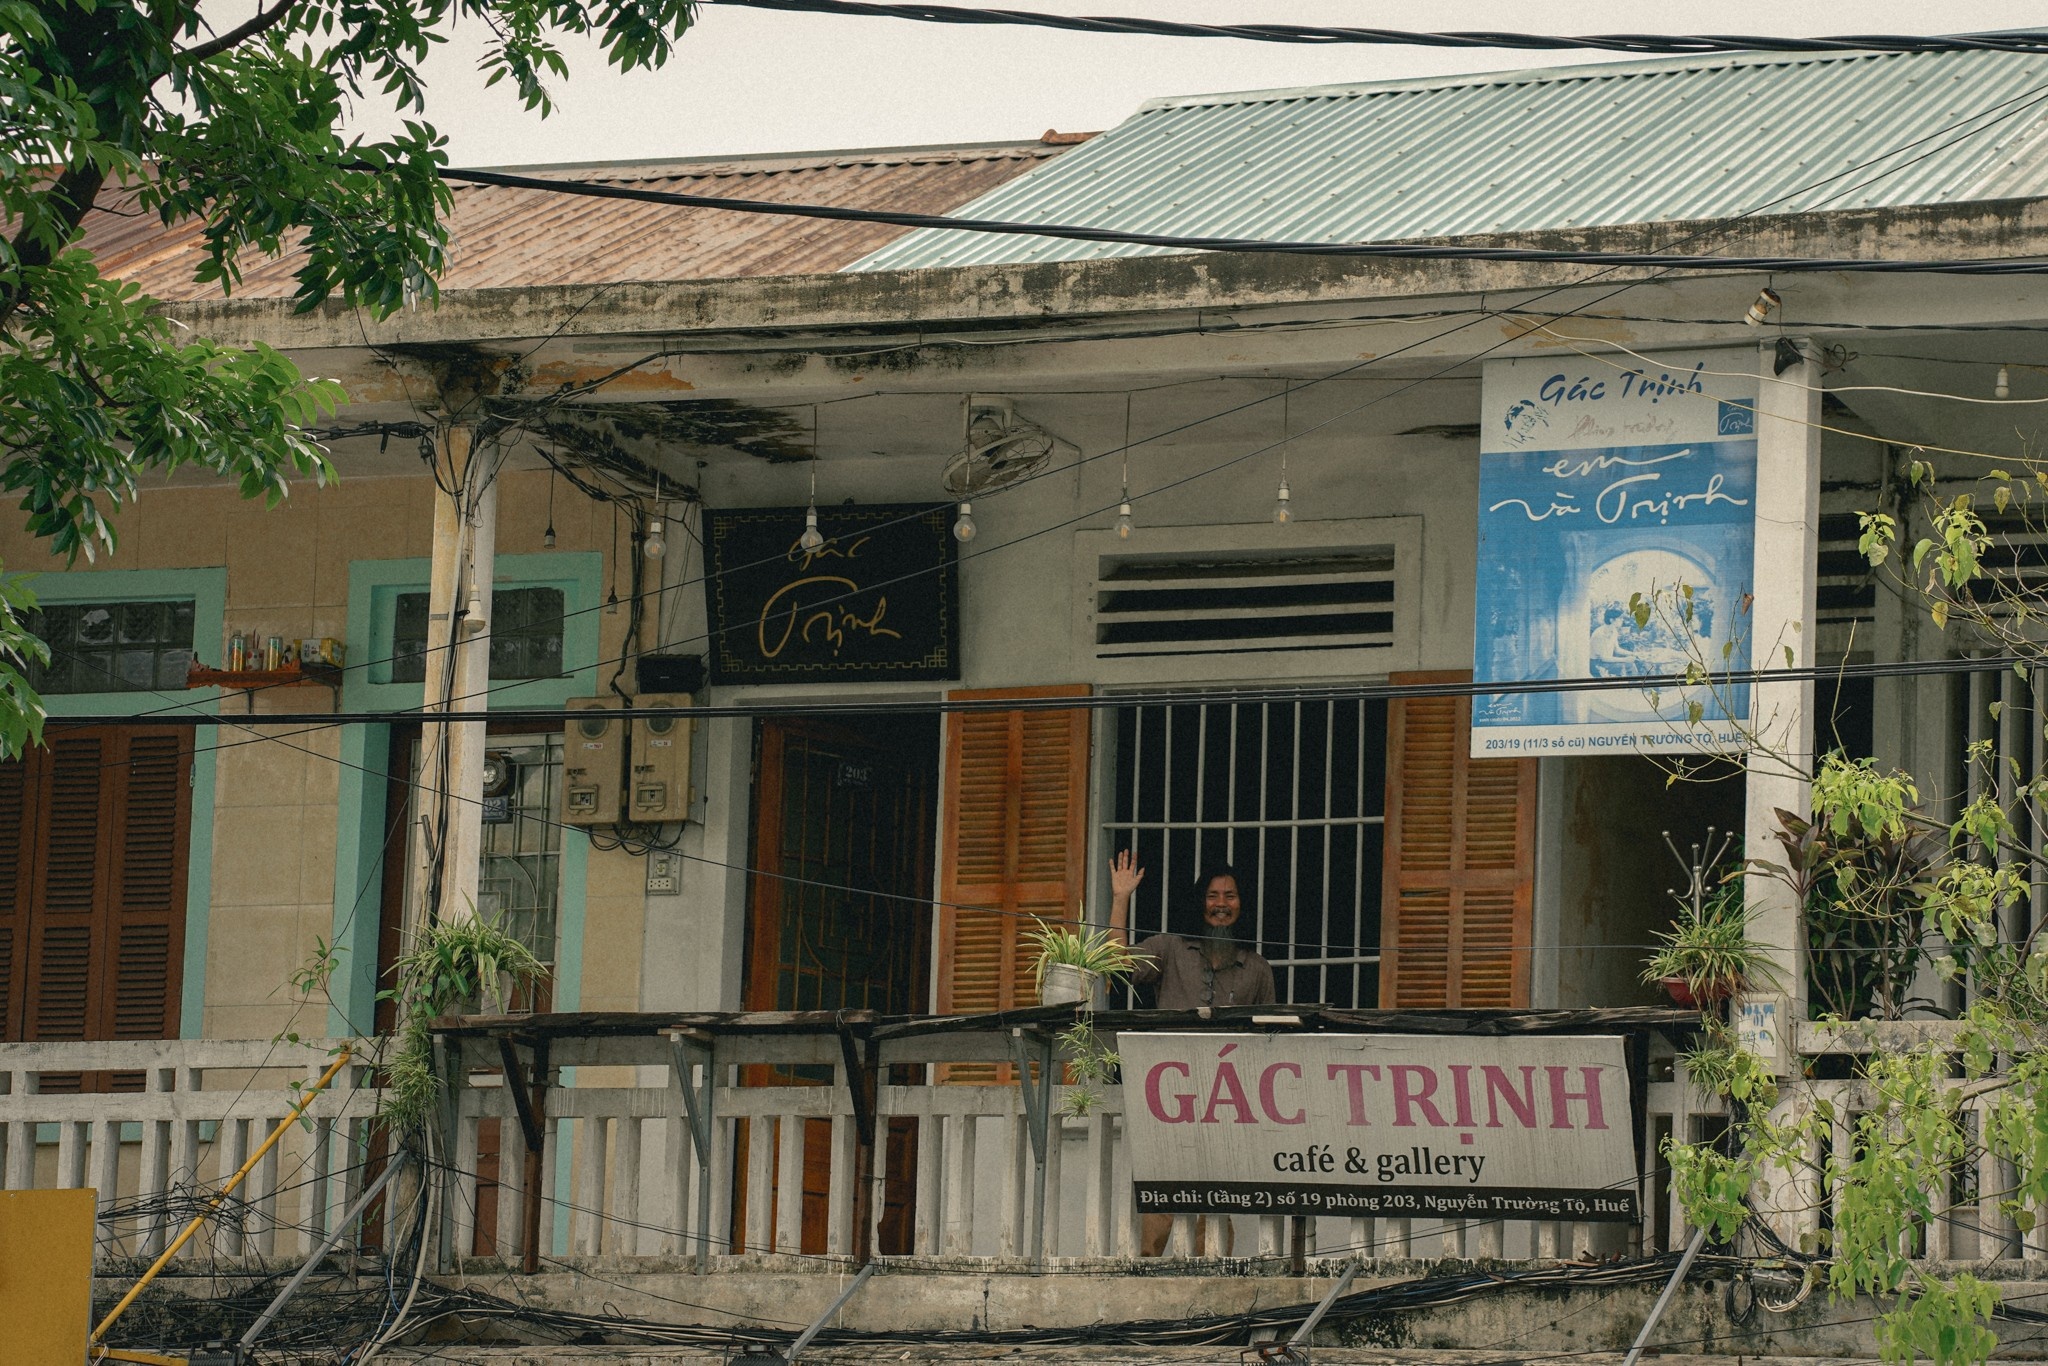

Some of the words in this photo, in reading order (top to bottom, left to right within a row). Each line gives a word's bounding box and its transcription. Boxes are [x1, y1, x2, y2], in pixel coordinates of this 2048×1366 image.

[1540, 374, 1606, 407] Gác
[1620, 361, 1704, 404] Trịnh
[1543, 448, 1690, 478] em
[1489, 491, 1581, 521] và
[1596, 473, 1748, 525] Trịnh
[758, 575, 903, 658] Trịnh
[1485, 738, 1521, 750] 203/19
[1523, 738, 1550, 751] (11/3
[1551, 735, 1566, 748] số
[1567, 736, 1586, 749] cũ)
[1588, 733, 1637, 747] NGUYỄN
[1640, 731, 1693, 745] TRƯỜNG
[1145, 1043, 1306, 1125] GÁC
[1327, 1064, 1609, 1145] TRỊNH
[1273, 1144, 1335, 1173] café
[1344, 1146, 1369, 1174] &
[1376, 1146, 1486, 1184] gallery
[1140, 1190, 1169, 1206] Địa
[1172, 1190, 1203, 1204] chỉ:
[1207, 1190, 1251, 1208] (tầng
[1255, 1191, 1272, 1208] 2)
[1277, 1191, 1296, 1205] số
[1300, 1192, 1321, 1206] 19
[1325, 1193, 1380, 1210] phòng
[1383, 1194, 1421, 1210] 203,
[1424, 1193, 1489, 1212] Nguyễn
[1491, 1196, 1560, 1214] Trường
[1562, 1198, 1590, 1214] Tộ,
[1593, 1198, 1630, 1212] Huế
